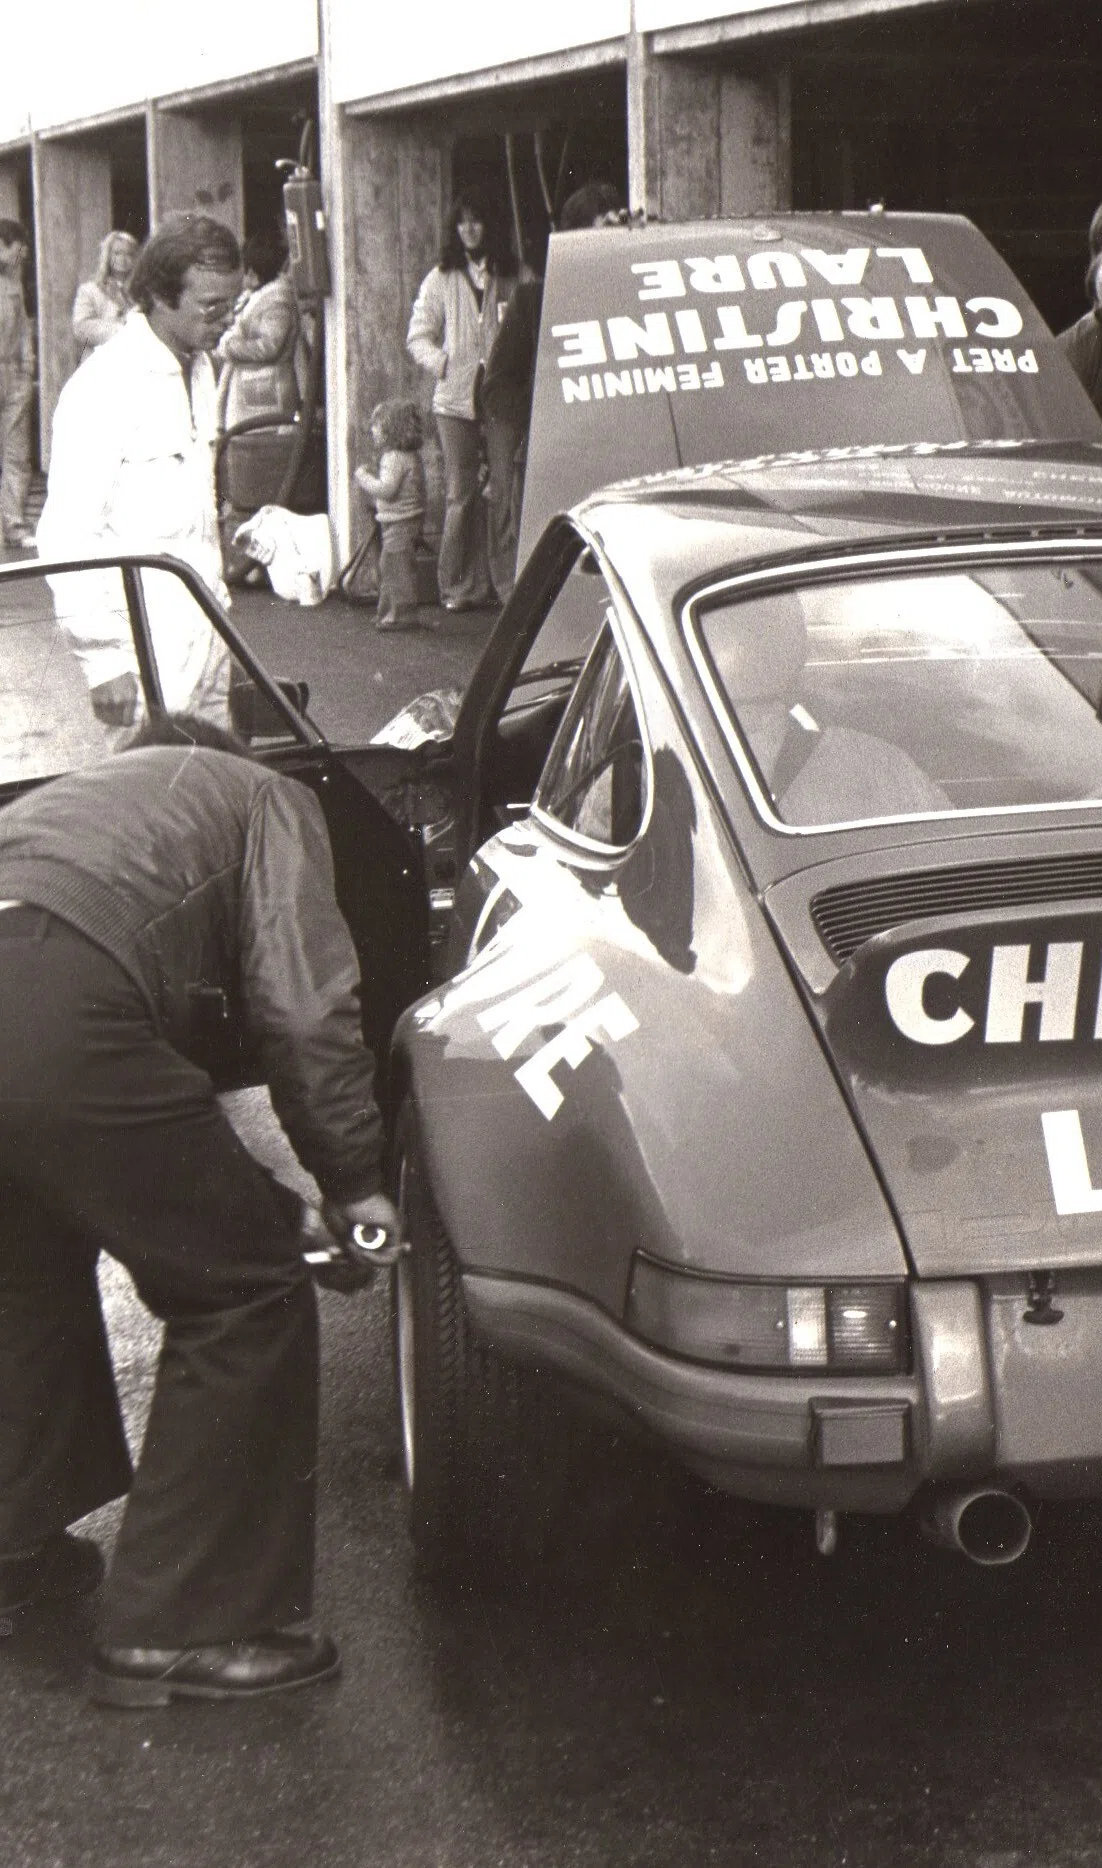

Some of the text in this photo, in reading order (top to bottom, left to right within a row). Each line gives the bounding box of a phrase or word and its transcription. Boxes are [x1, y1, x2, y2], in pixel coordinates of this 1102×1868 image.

[630, 247, 934, 300] LAURE
[551, 296, 1024, 369] CHRISTINE
[561, 348, 1039, 404] PRET A PORTER FEMININ
